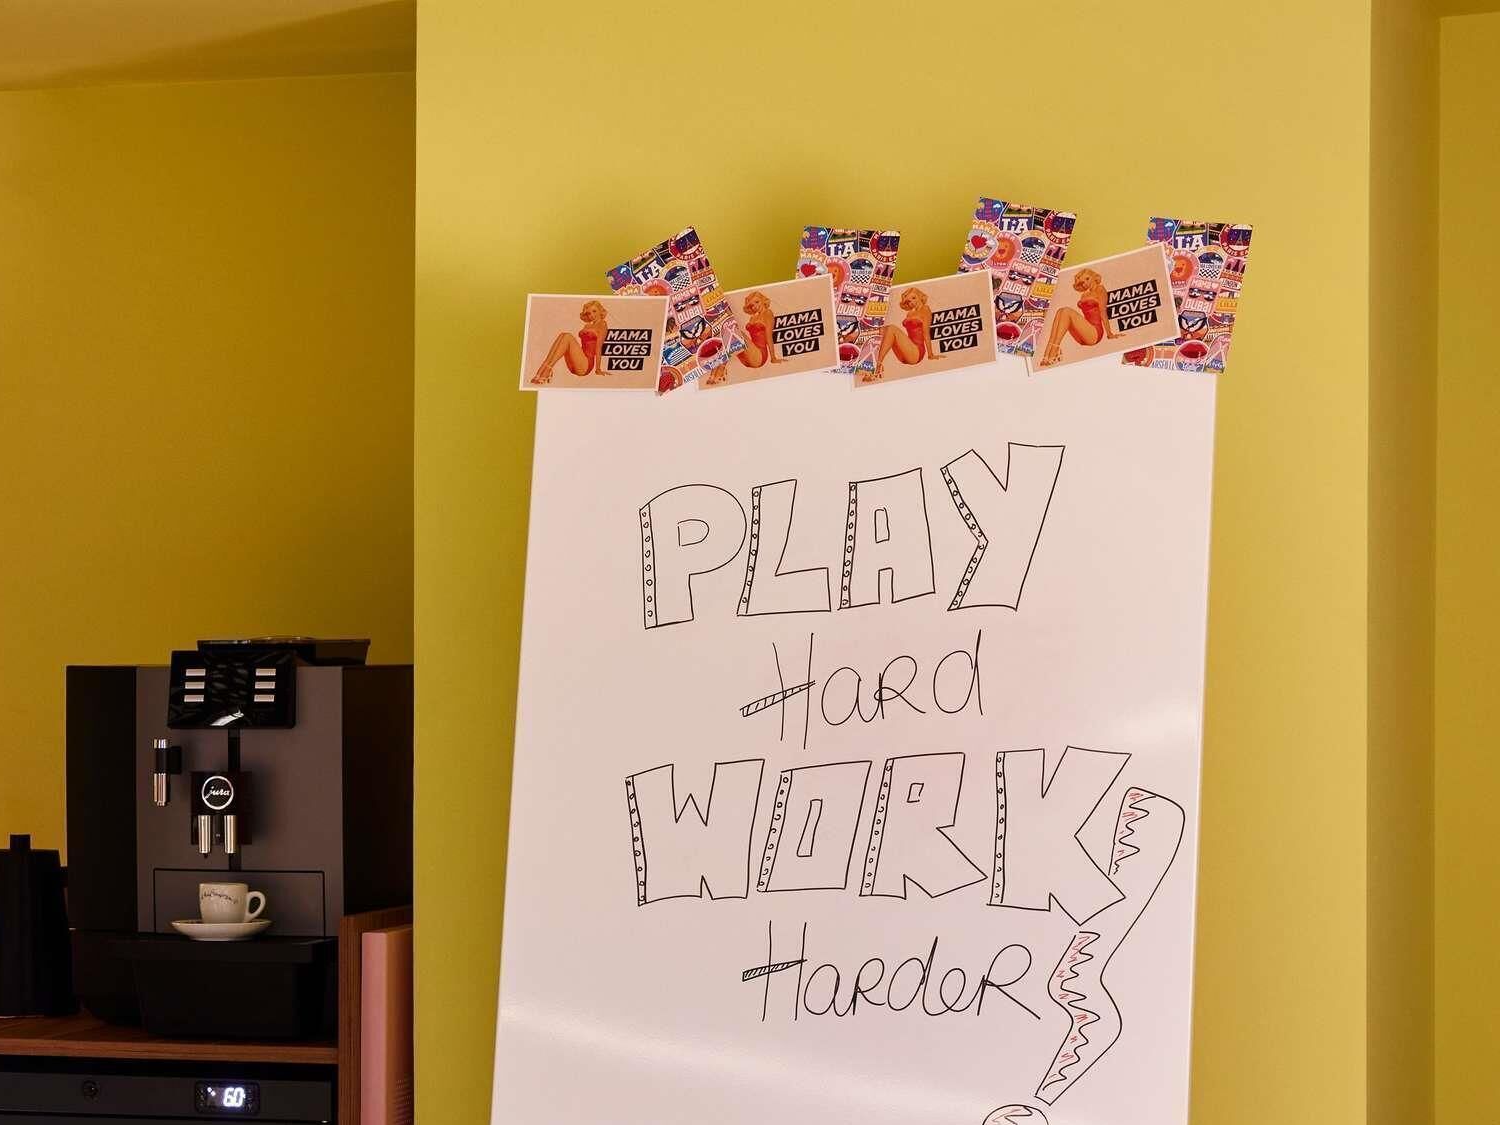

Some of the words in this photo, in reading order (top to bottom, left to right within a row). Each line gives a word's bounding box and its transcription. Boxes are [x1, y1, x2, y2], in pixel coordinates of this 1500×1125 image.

[1108, 281, 1154, 303] MAMA
[932, 306, 977, 324] MAMA
[1110, 296, 1157, 318] LOVES
[775, 311, 820, 328] MAMA
[1120, 313, 1153, 330] YOU
[606, 330, 649, 342] MAMA
[776, 325, 821, 343] LOVES
[933, 320, 979, 338] LOVES
[604, 344, 648, 356] LOVES
[785, 340, 816, 356] YOU
[942, 336, 974, 352] YOU
[611, 358, 641, 369] YOU
[639, 441, 1066, 630] PLAY
[204, 785, 231, 800] jura
[626, 746, 1132, 926] WORK
